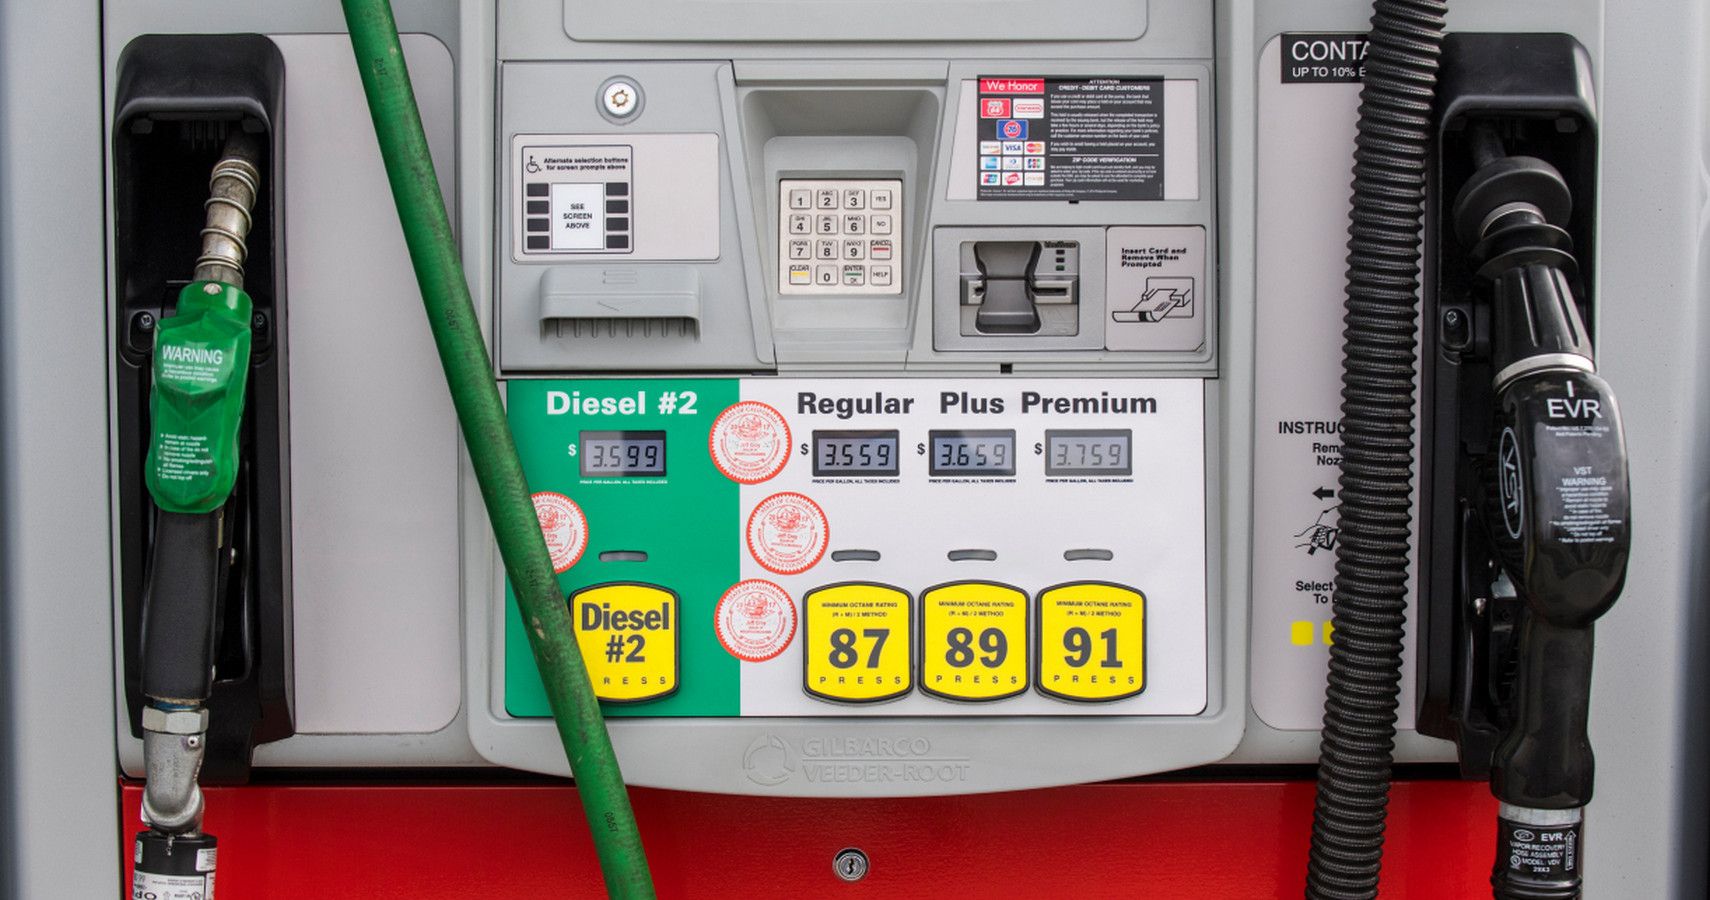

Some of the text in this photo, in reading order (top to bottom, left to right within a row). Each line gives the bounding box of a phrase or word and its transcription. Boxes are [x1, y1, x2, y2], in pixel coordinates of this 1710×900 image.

[1292, 67, 1309, 77] UP
[1312, 67, 1329, 77] TO
[1332, 67, 1356, 77] 10%
[986, 80, 1038, 91] We Honor
[797, 197, 803, 206] 1
[823, 197, 831, 207] 2
[850, 197, 858, 207] 3
[563, 212, 593, 220] SCREEN
[796, 222, 804, 231] 4
[823, 222, 831, 232] 5
[850, 222, 858, 232] 6
[796, 248, 804, 256] 7
[823, 248, 831, 257] 8
[850, 248, 858, 257] 9
[823, 273, 831, 282] 0
[163, 345, 223, 365] WARNING
[547, 391, 698, 415] Diesel #2
[797, 392, 915, 420] Regular
[940, 391, 1005, 415] Plus
[1021, 391, 1158, 415] Premium
[1546, 398, 1602, 418] EVR
[1313, 443, 1342, 453] Rem
[567, 443, 658, 468] $ 3.599
[800, 443, 890, 466] $ 3.559
[917, 442, 1006, 466] $ 3.659
[1034, 442, 1121, 466] $ 3.759
[1572, 466, 1592, 475] VST
[1561, 477, 1607, 486] WARNING
[1295, 580, 1333, 591] Select
[1313, 593, 1328, 604] To
[581, 602, 670, 631] Diesel
[605, 635, 646, 663] #2
[828, 628, 890, 669] 87
[945, 627, 1008, 668] 89
[1063, 627, 1123, 668] 91
[603, 677, 666, 685] RESS
[802, 737, 931, 757] GILBARCO
[802, 764, 970, 783] VEEDER-ROOT
[1541, 833, 1563, 841] EVR
